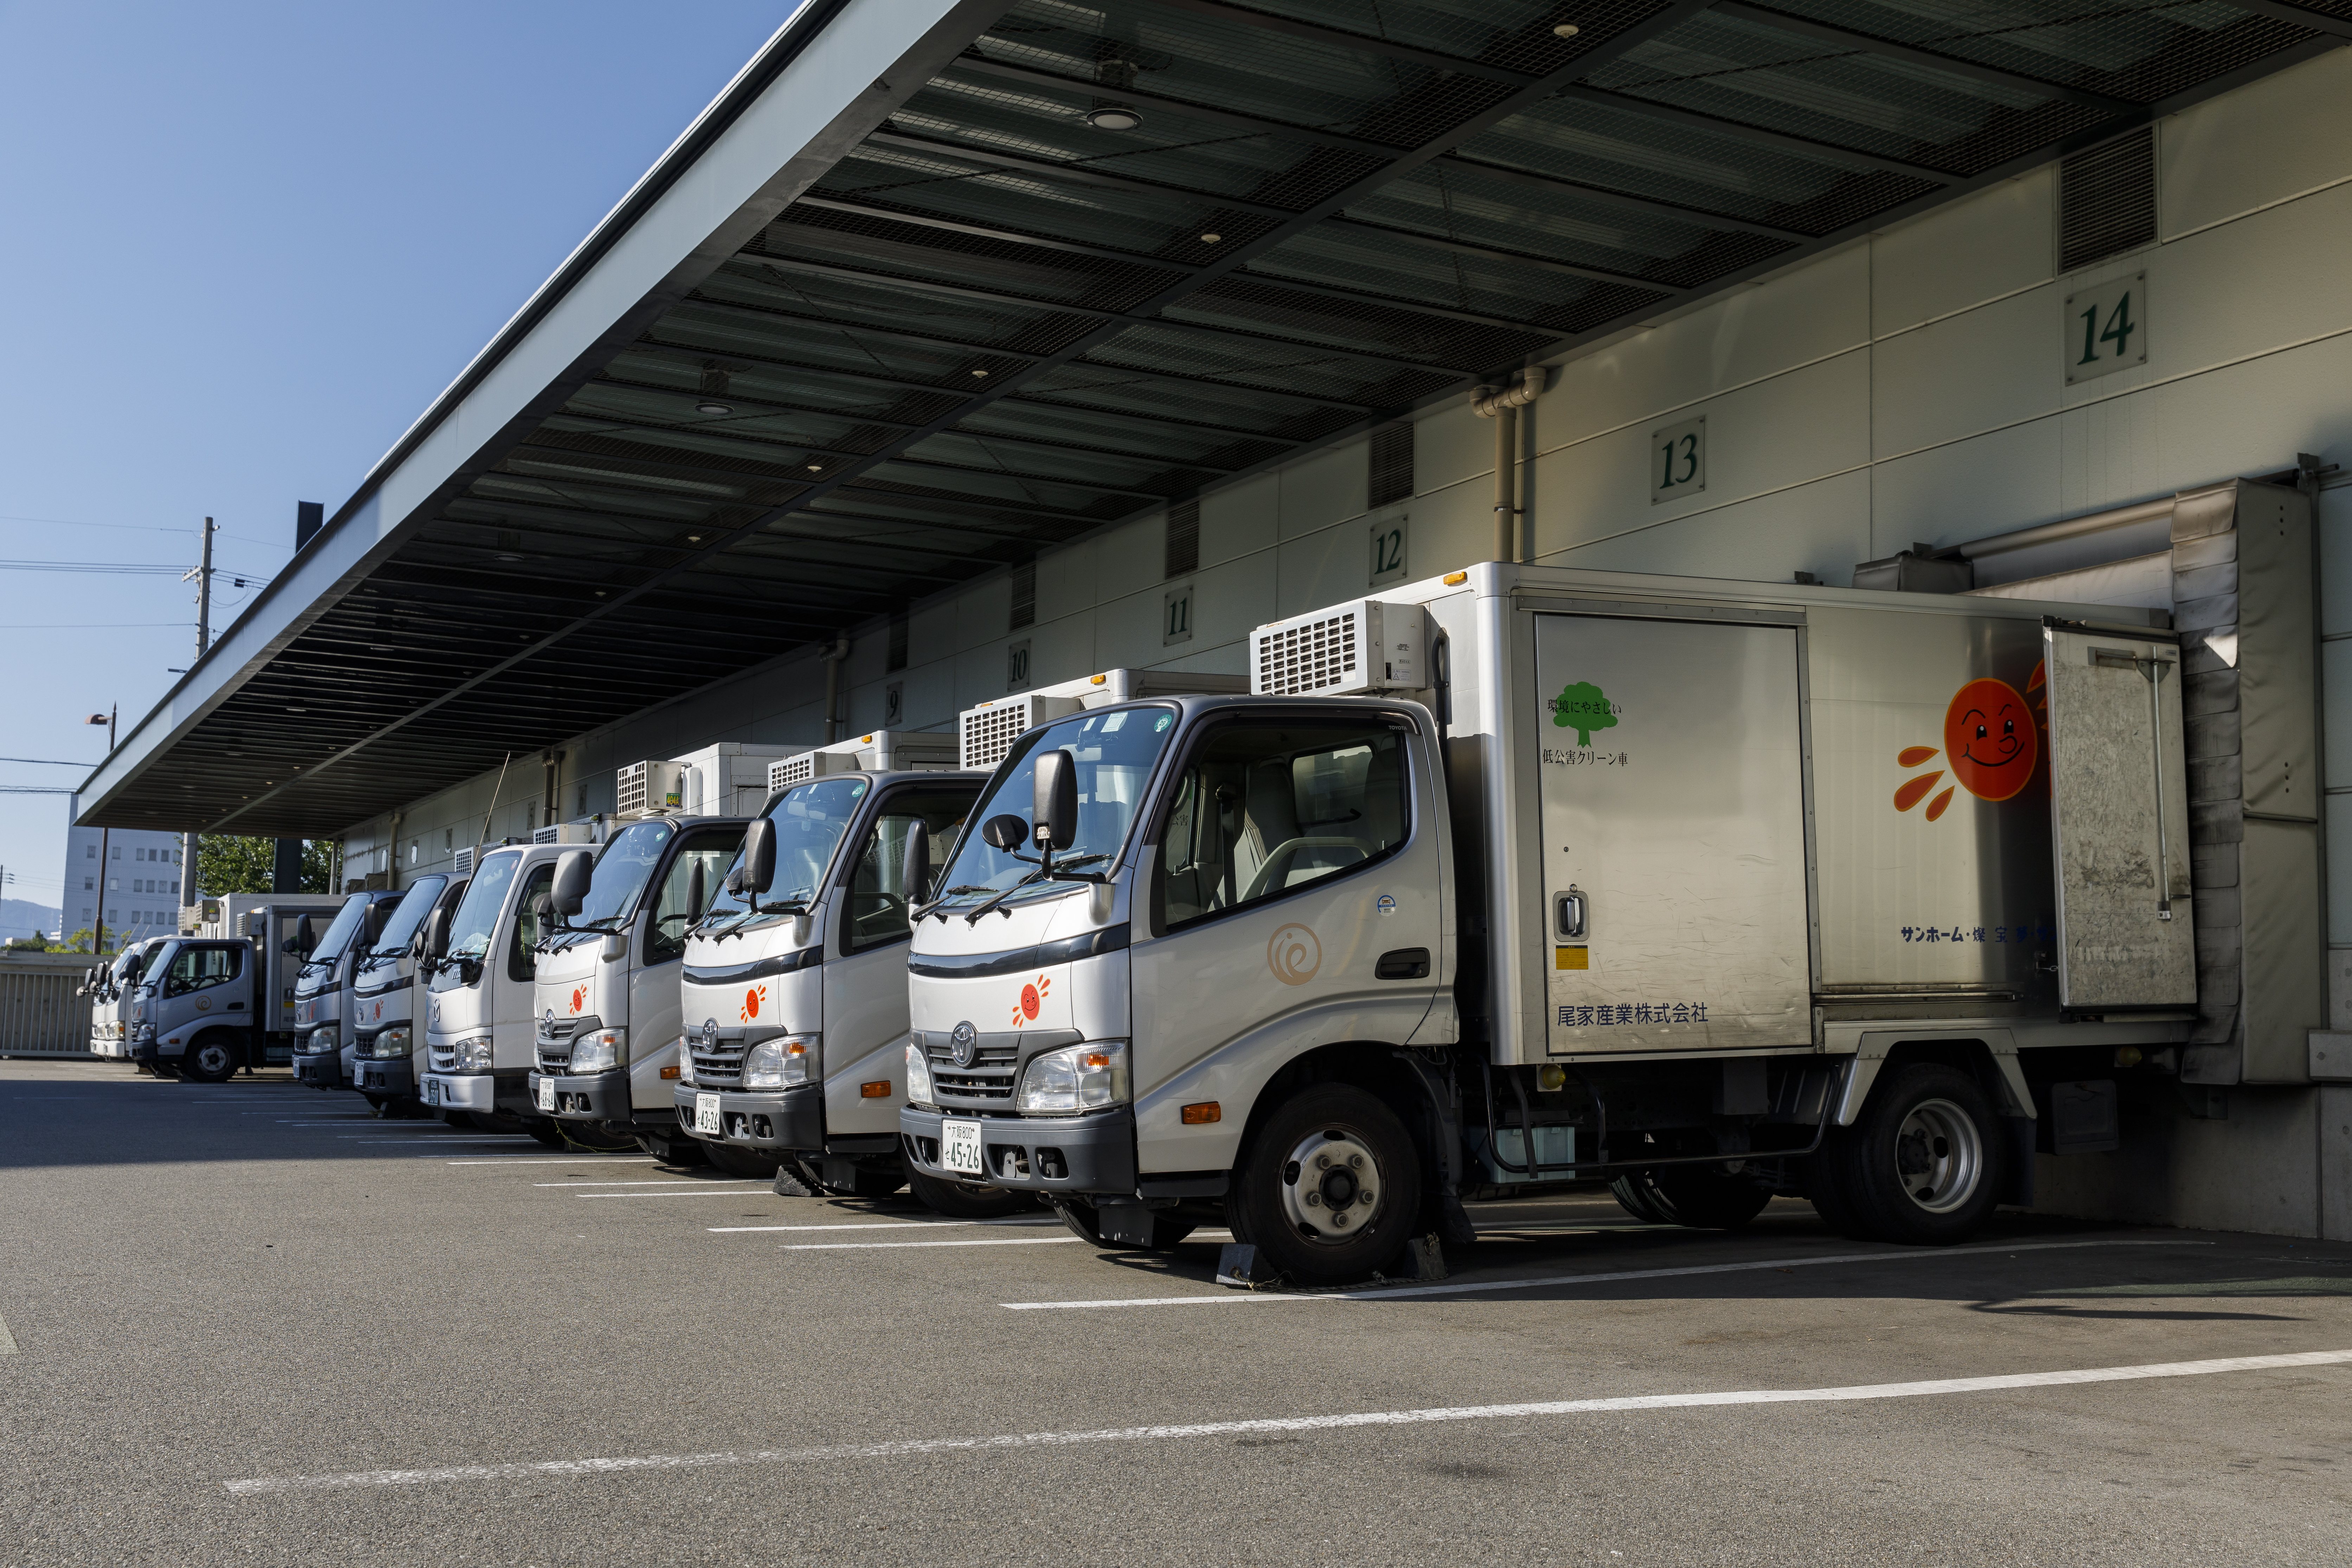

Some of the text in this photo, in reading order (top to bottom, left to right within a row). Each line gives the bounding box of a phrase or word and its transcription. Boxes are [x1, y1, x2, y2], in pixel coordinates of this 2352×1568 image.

[2077, 290, 2135, 366] 14
[1659, 434, 1697, 489] 13
[1374, 529, 1402, 575] 12
[1168, 597, 1187, 636] 11
[1011, 649, 1027, 682] 10
[889, 691, 898, 718] 9
[1547, 699, 1621, 715] 環境にやさしい
[1543, 749, 1628, 767] 低公害クリーン車
[667, 796, 679, 805] 404A
[1557, 1001, 1709, 1027] 尾家産業株式会社
[543, 1092, 553, 1107] 68-64
[702, 1098, 715, 1108] 大阪800
[701, 1110, 718, 1131] 43-26
[951, 1126, 972, 1139] 大阪800
[945, 1142, 979, 1169] せ 45-26
